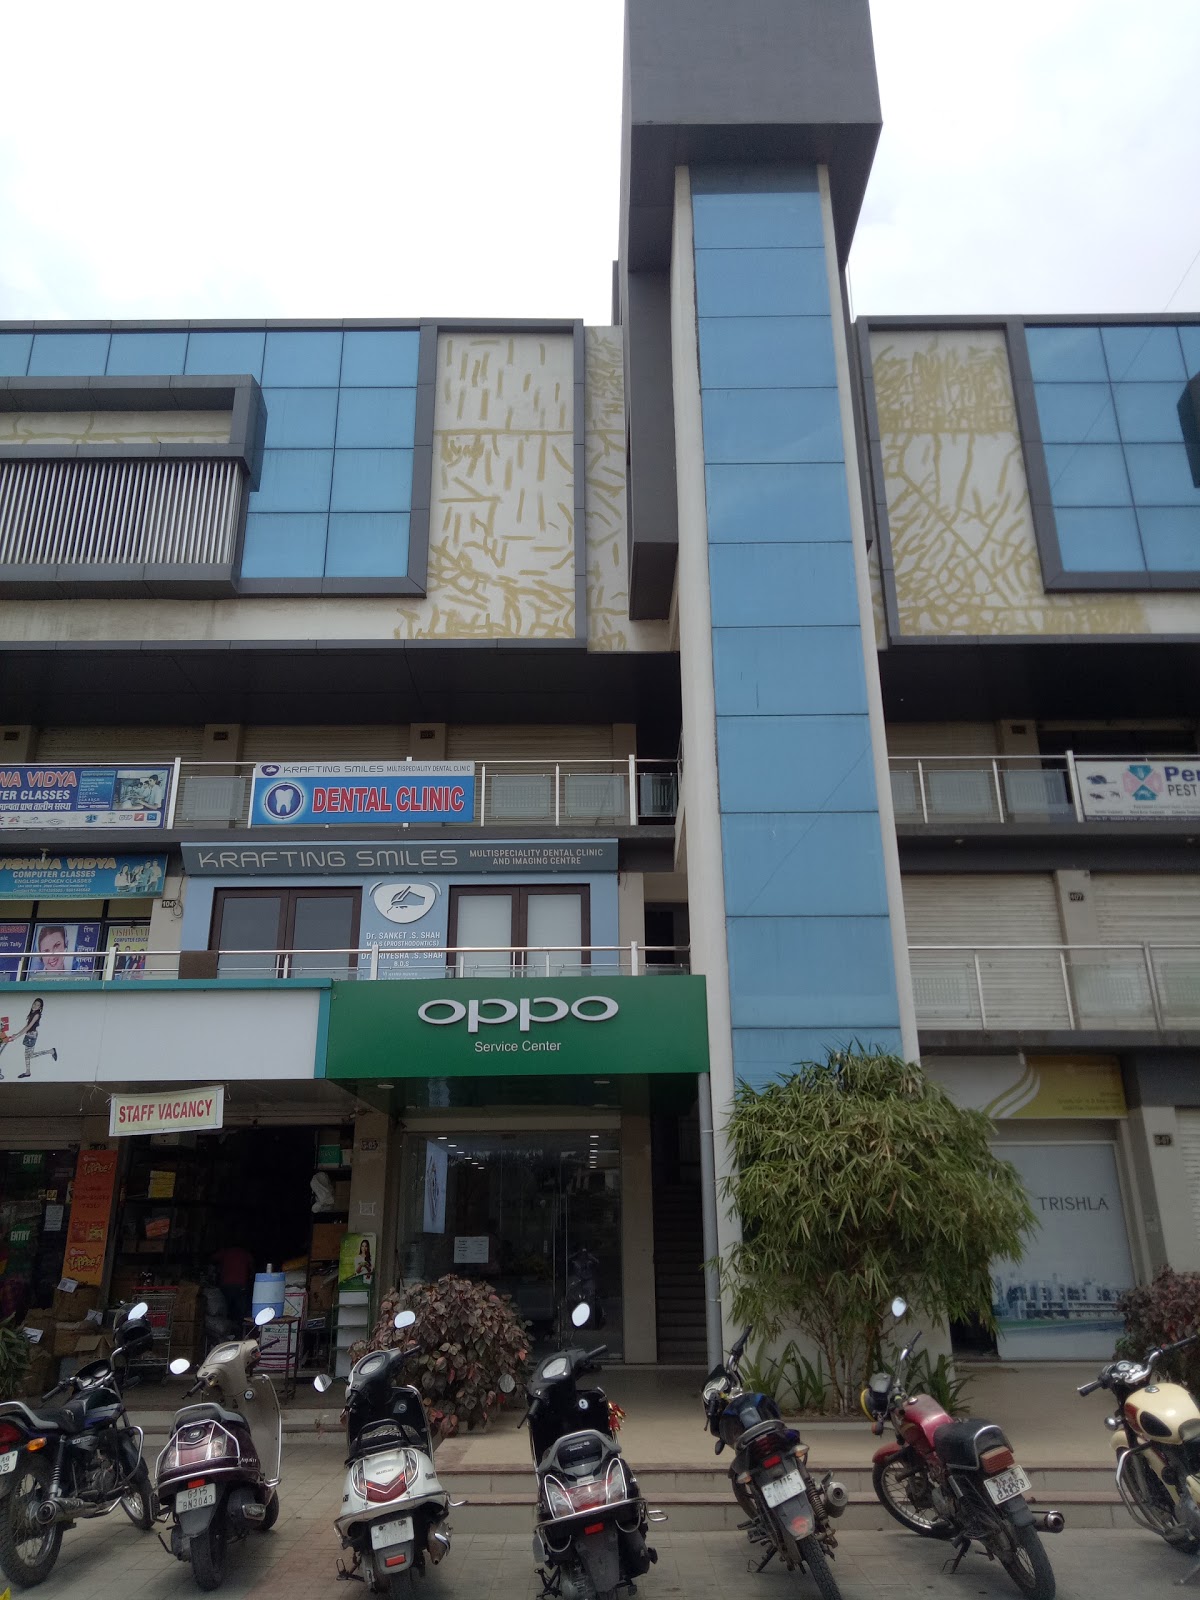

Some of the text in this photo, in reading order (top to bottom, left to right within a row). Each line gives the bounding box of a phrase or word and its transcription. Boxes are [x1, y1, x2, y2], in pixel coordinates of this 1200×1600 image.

[283, 766, 341, 774] KRAFTING
[344, 765, 384, 773] SMILES
[386, 765, 431, 773] MULTISPECIALITY
[453, 764, 471, 772] CLINIC
[27, 771, 77, 787] VIDYA
[21, 790, 71, 800] CLASSES
[1167, 784, 1198, 796] PEST
[312, 785, 465, 813] DENTAL CLINIC
[470, 848, 603, 858] MULTISPECIALITY DENTAL CLINIC
[66, 857, 117, 869] VIDYA
[198, 850, 458, 868] KRAFTING SMILES
[492, 856, 581, 865] AND IMAGING CENTRE
[60, 870, 96, 878] CLASSES
[366, 932, 376, 940] Dr.
[379, 931, 407, 940] SANKET
[421, 931, 440, 939] SHAH
[361, 952, 372, 960] Dr.
[378, 952, 409, 960] RIYESHA
[474, 1040, 562, 1052] Service Center
[119, 1099, 213, 1124] STAFF VACANCY
[23, 1154, 42, 1164] ENTRY
[1038, 1197, 1109, 1211] TRISHLA
[10, 1230, 30, 1241] ENTRY
